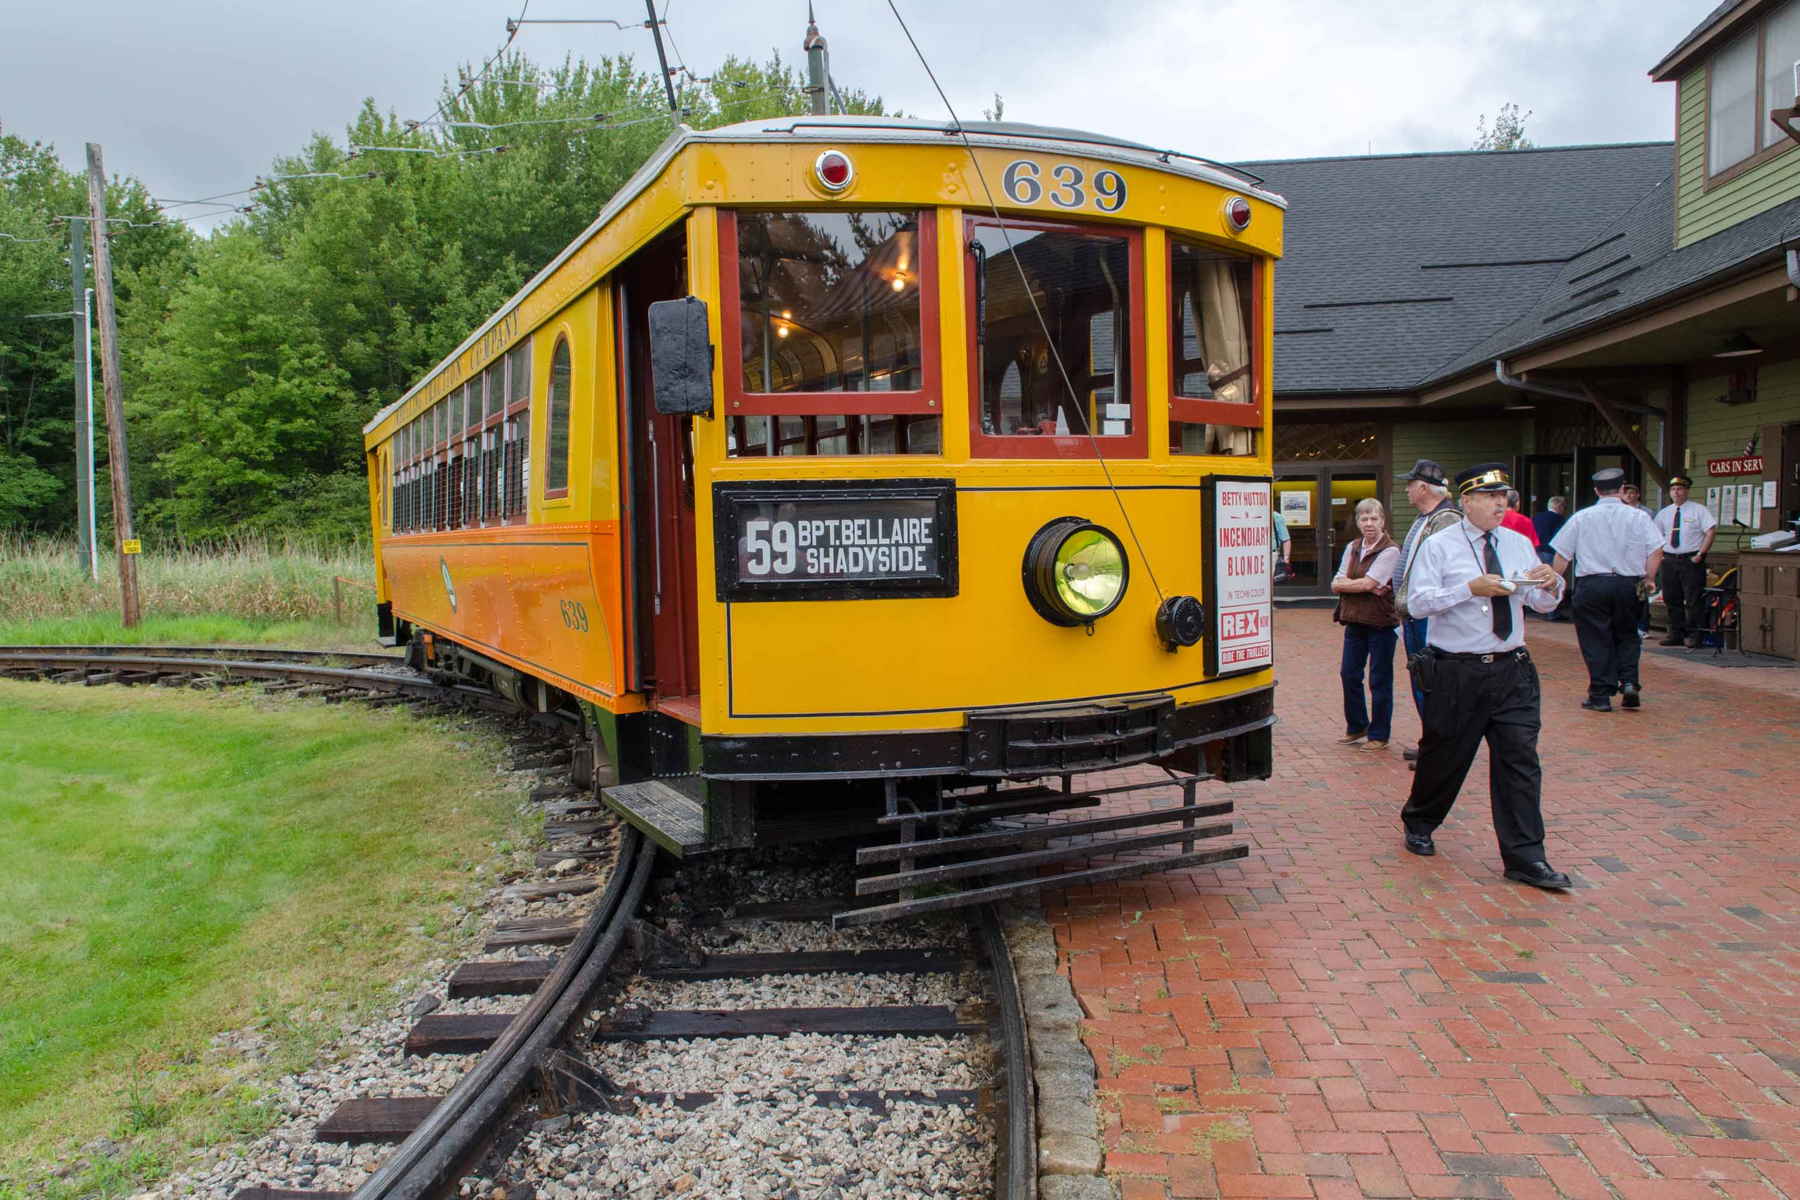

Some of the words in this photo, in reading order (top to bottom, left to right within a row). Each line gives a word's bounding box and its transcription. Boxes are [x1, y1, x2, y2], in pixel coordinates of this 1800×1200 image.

[1002, 160, 1127, 213] 639
[470, 307, 521, 370] COMPANY
[1711, 462, 1730, 473] CARS
[1732, 461, 1741, 472] IN
[1222, 491, 1242, 506] BETTY
[1243, 491, 1268, 506] HUTTON
[746, 520, 796, 575] 59
[1220, 526, 1269, 548] INCENDIARY
[806, 546, 927, 574] SHADYSIDE
[1228, 554, 1265, 576] BLONDE
[560, 600, 589, 632] 639
[1223, 610, 1257, 638] REX
